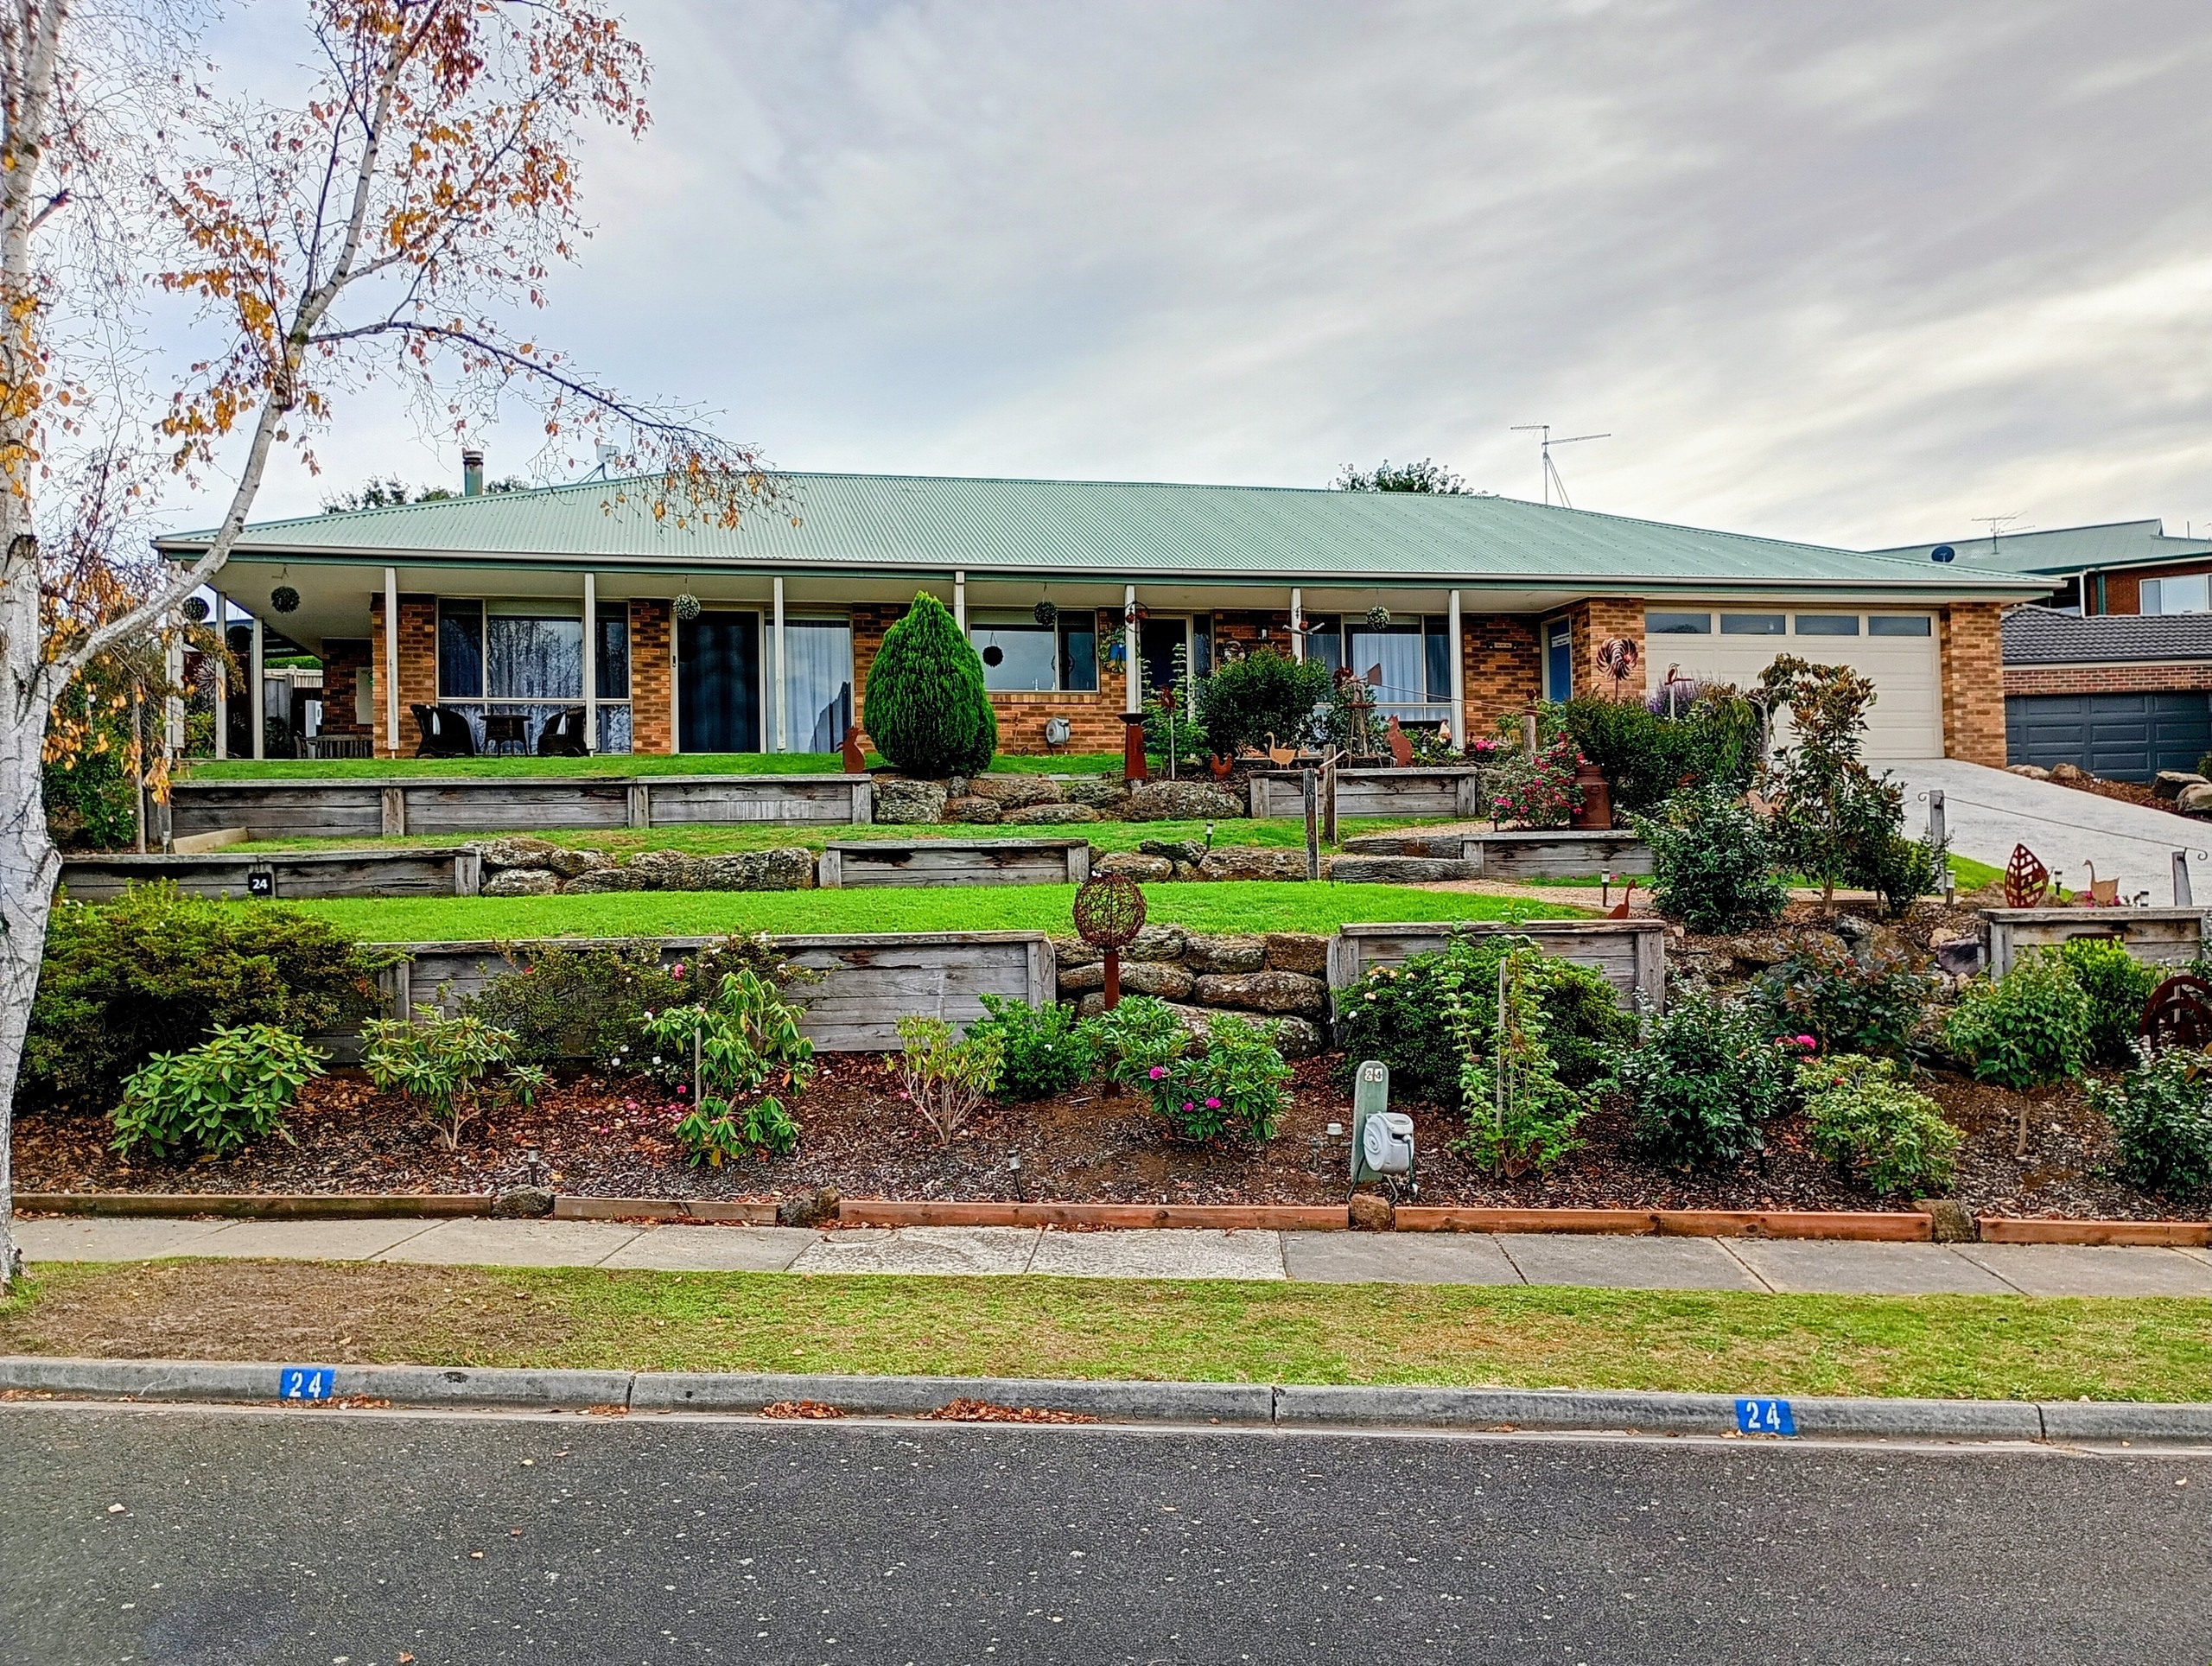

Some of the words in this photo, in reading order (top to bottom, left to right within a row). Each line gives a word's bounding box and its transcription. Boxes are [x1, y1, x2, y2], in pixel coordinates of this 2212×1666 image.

[252, 879, 268, 889] 24
[1365, 1069, 1382, 1080] 24
[289, 1371, 321, 1398] 24
[1746, 1402, 1781, 1430] 24
